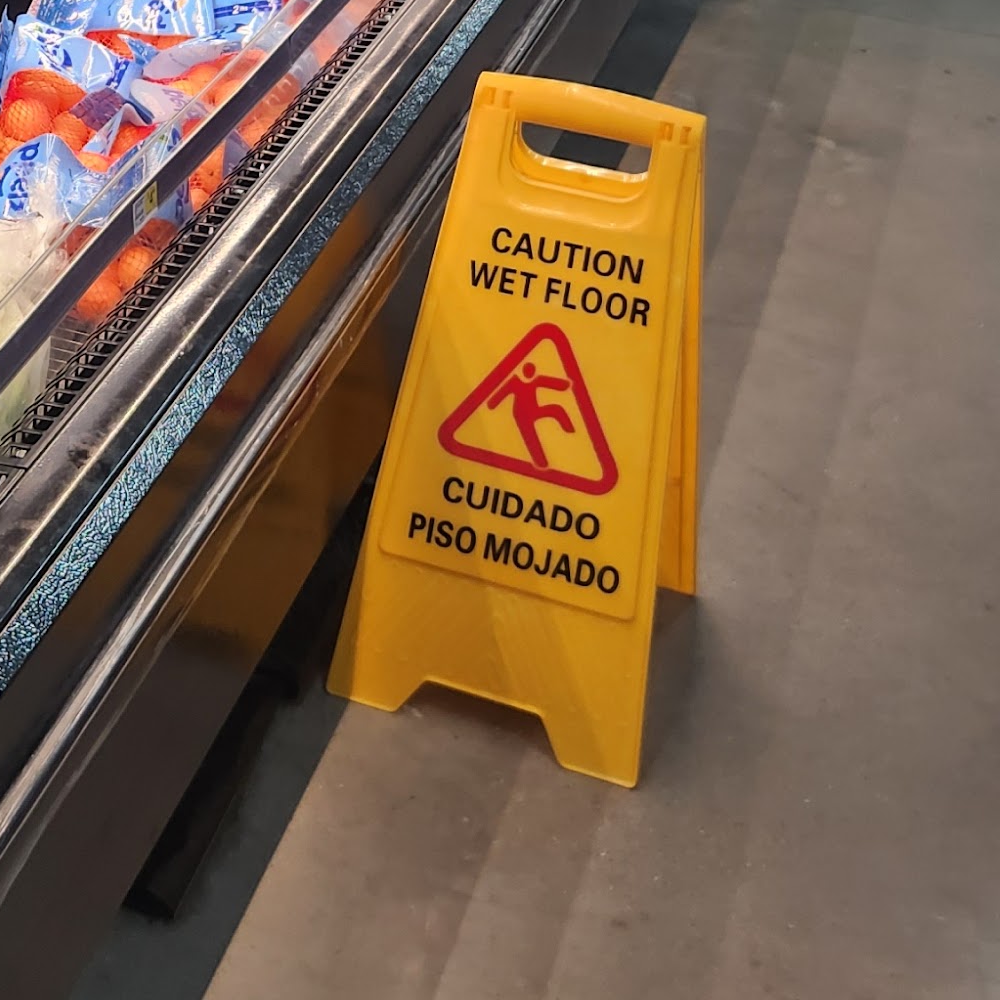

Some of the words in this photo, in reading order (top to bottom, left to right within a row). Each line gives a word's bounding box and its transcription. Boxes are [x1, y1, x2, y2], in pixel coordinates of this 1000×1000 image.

[491, 227, 645, 285] CAUTION
[470, 260, 538, 299] WET
[543, 278, 651, 327] FLOOR
[442, 476, 600, 541] CUIDADO
[407, 512, 477, 555] PISO
[483, 533, 620, 595] MOJADO
